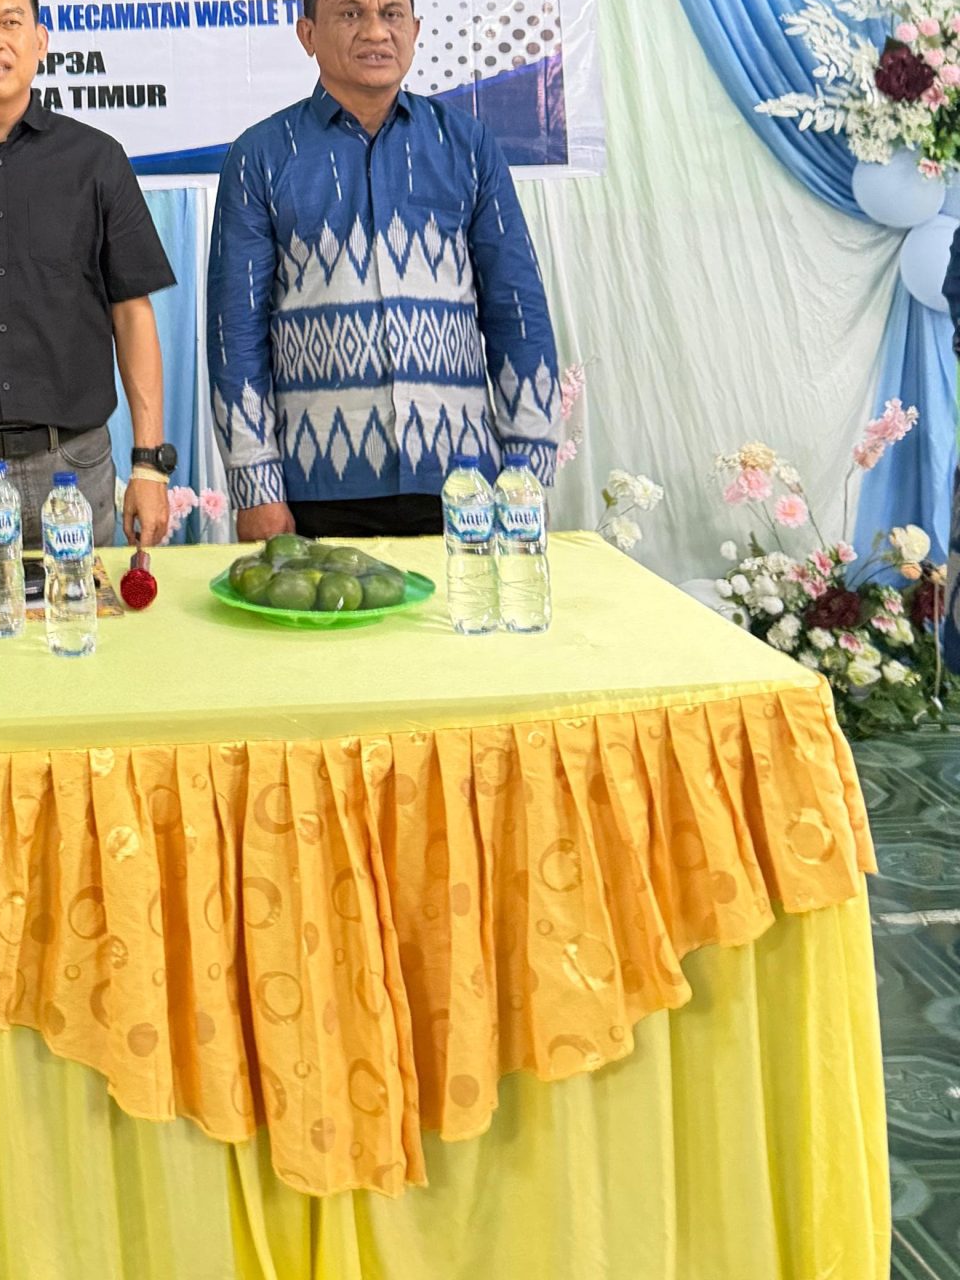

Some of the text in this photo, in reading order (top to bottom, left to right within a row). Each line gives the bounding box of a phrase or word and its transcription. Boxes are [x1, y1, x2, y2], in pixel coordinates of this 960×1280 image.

[57, 1, 191, 32] KECAMATAN
[195, 0, 279, 28] WASILE
[68, 84, 167, 110] TIMUR
[460, 511, 489, 526] AQUA
[507, 511, 538, 525] AQUA
[55, 529, 86, 545] AQUA
